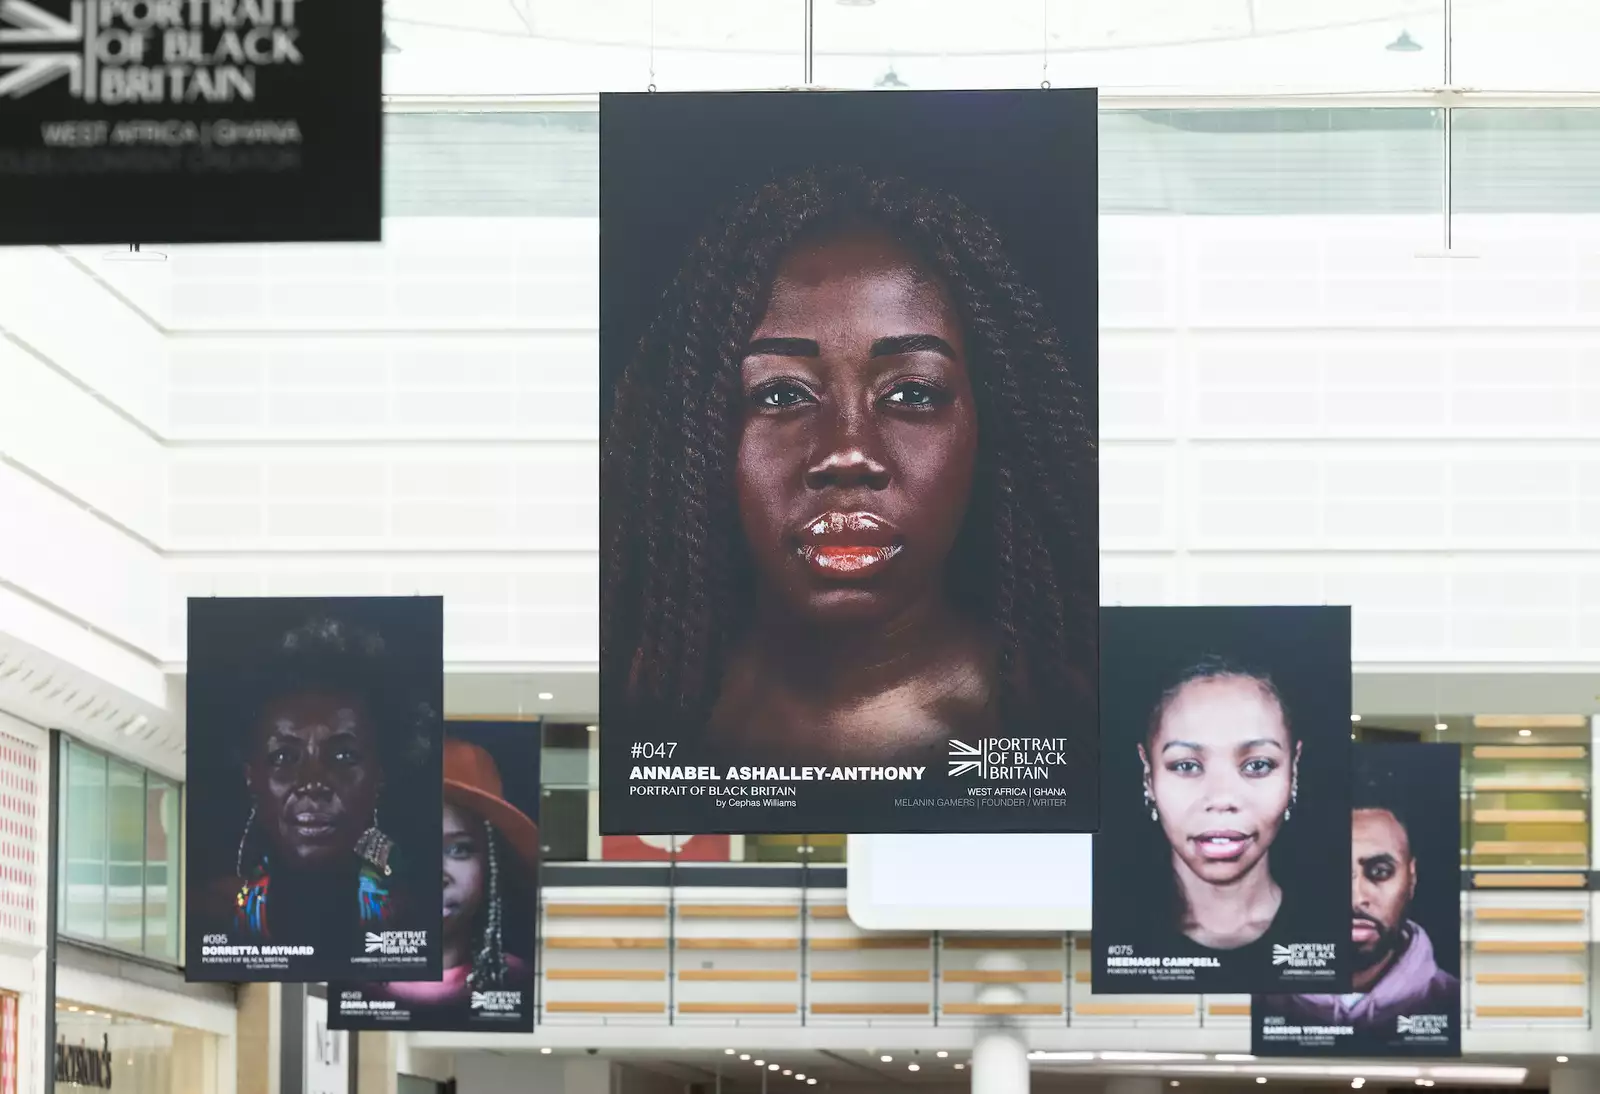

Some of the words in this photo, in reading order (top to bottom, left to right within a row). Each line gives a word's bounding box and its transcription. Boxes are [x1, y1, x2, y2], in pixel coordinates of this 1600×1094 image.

[100, 0, 297, 28] PORTRAIT
[96, 28, 149, 65] OF
[162, 28, 303, 64] BLACK
[100, 65, 256, 104] BRITAIN
[41, 120, 110, 146] WEST
[110, 120, 200, 146] AFRICA
[211, 119, 302, 145] GHANA
[630, 741, 678, 759] #047
[989, 738, 1068, 751] PORTRAIT
[987, 752, 1010, 765] OF
[1014, 752, 1067, 765] BLACK
[629, 766, 721, 780] ANNABEL
[725, 766, 927, 781] ASHALLEY-ANTHONY
[989, 766, 1049, 780] BRITAIN
[629, 786, 688, 796] PORTRAIT
[689, 786, 707, 796] OF
[708, 786, 749, 796] BLACK
[751, 786, 797, 796] BRITAIN
[967, 788, 993, 796] WEST
[993, 788, 1028, 796] AFRICA
[1033, 788, 1067, 796] GHANA
[715, 798, 726, 809] by
[728, 799, 761, 808] Cephas
[762, 799, 797, 808] Williams
[894, 799, 935, 808] MELANIN
[936, 799, 975, 808] GAMERS
[981, 799, 1025, 808] FOUNDER
[1032, 799, 1067, 808] WRITER
[202, 933, 228, 944] #095
[202, 945, 260, 956] DORRETTA
[261, 945, 315, 956] MAYNARD
[1107, 944, 1134, 955] #075
[1162, 957, 1221, 967] CAMPBELL
